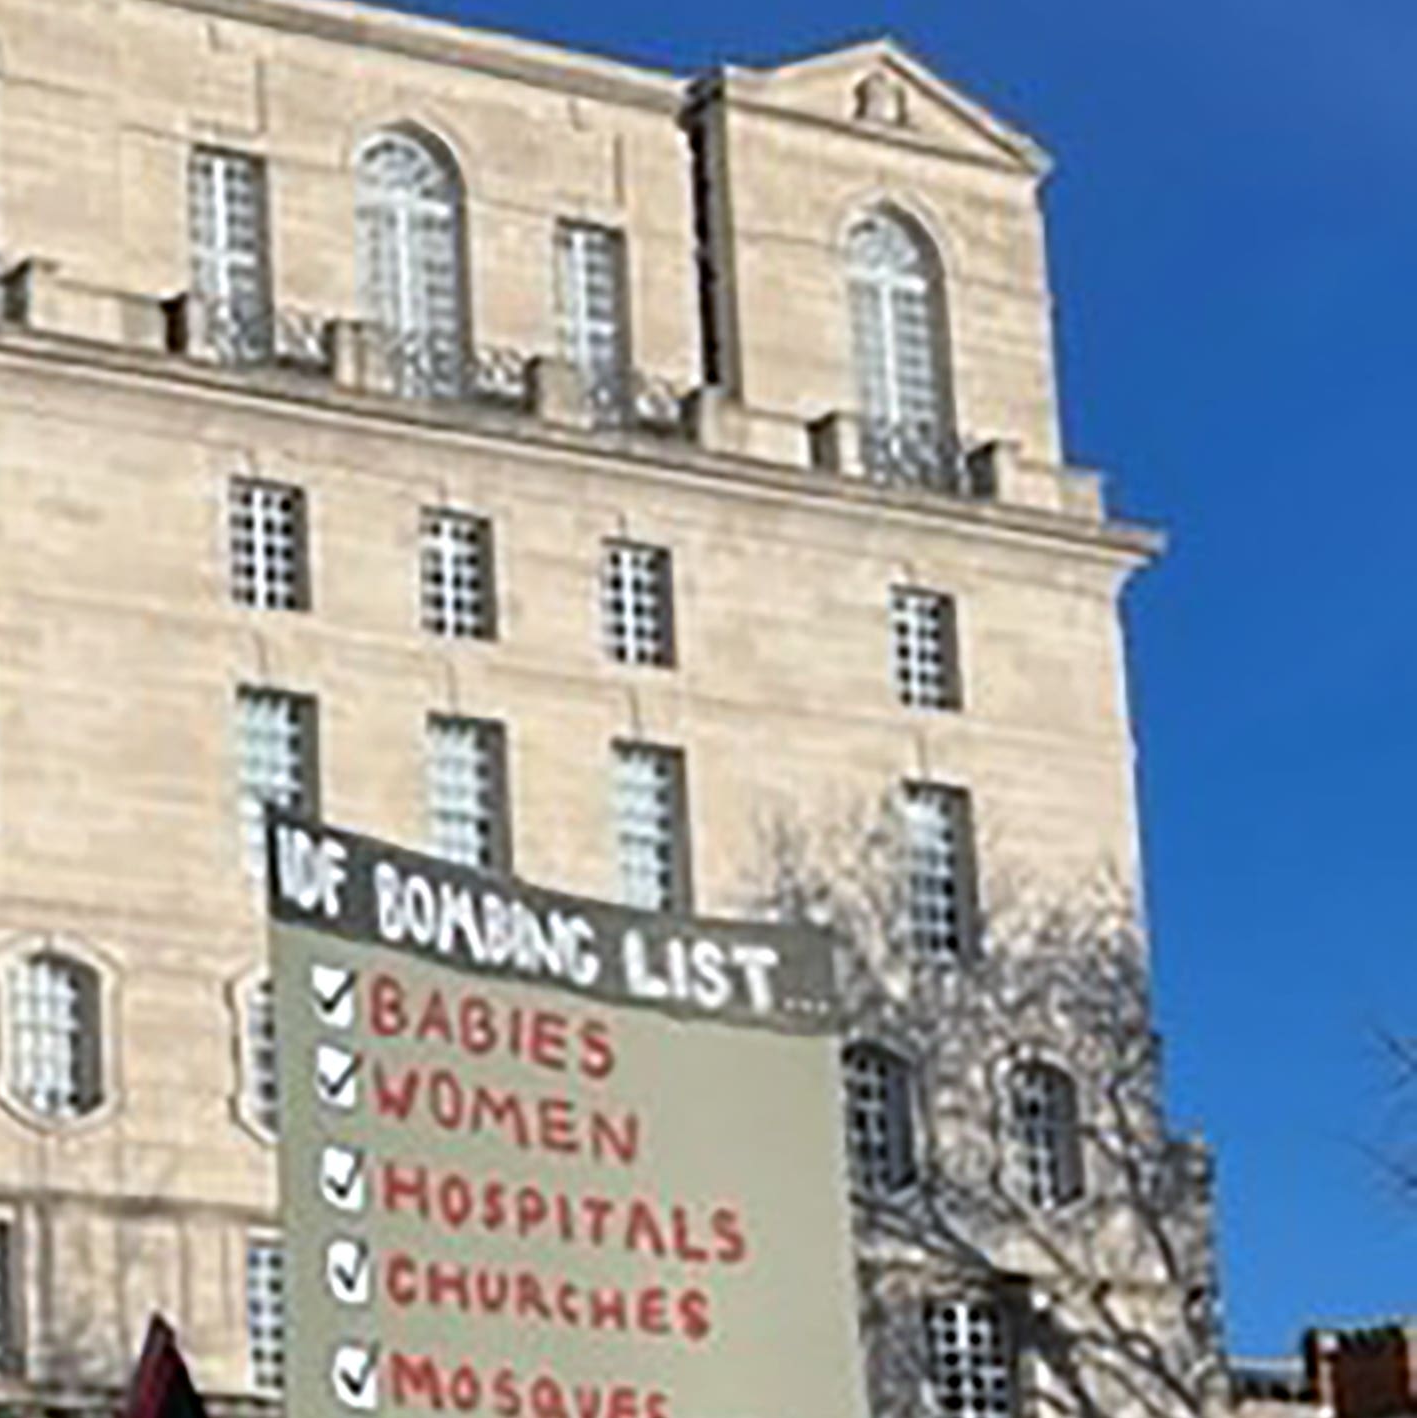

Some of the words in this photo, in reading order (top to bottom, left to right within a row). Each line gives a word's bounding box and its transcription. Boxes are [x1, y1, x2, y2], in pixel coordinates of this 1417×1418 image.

[276, 824, 349, 919] IDF
[373, 861, 601, 986] BOMBING
[369, 972, 616, 1080] BABIES
[373, 1063, 638, 1165] WOMEN
[381, 1161, 748, 1264] HOSPITALS
[384, 1254, 712, 1341] CHURCHES
